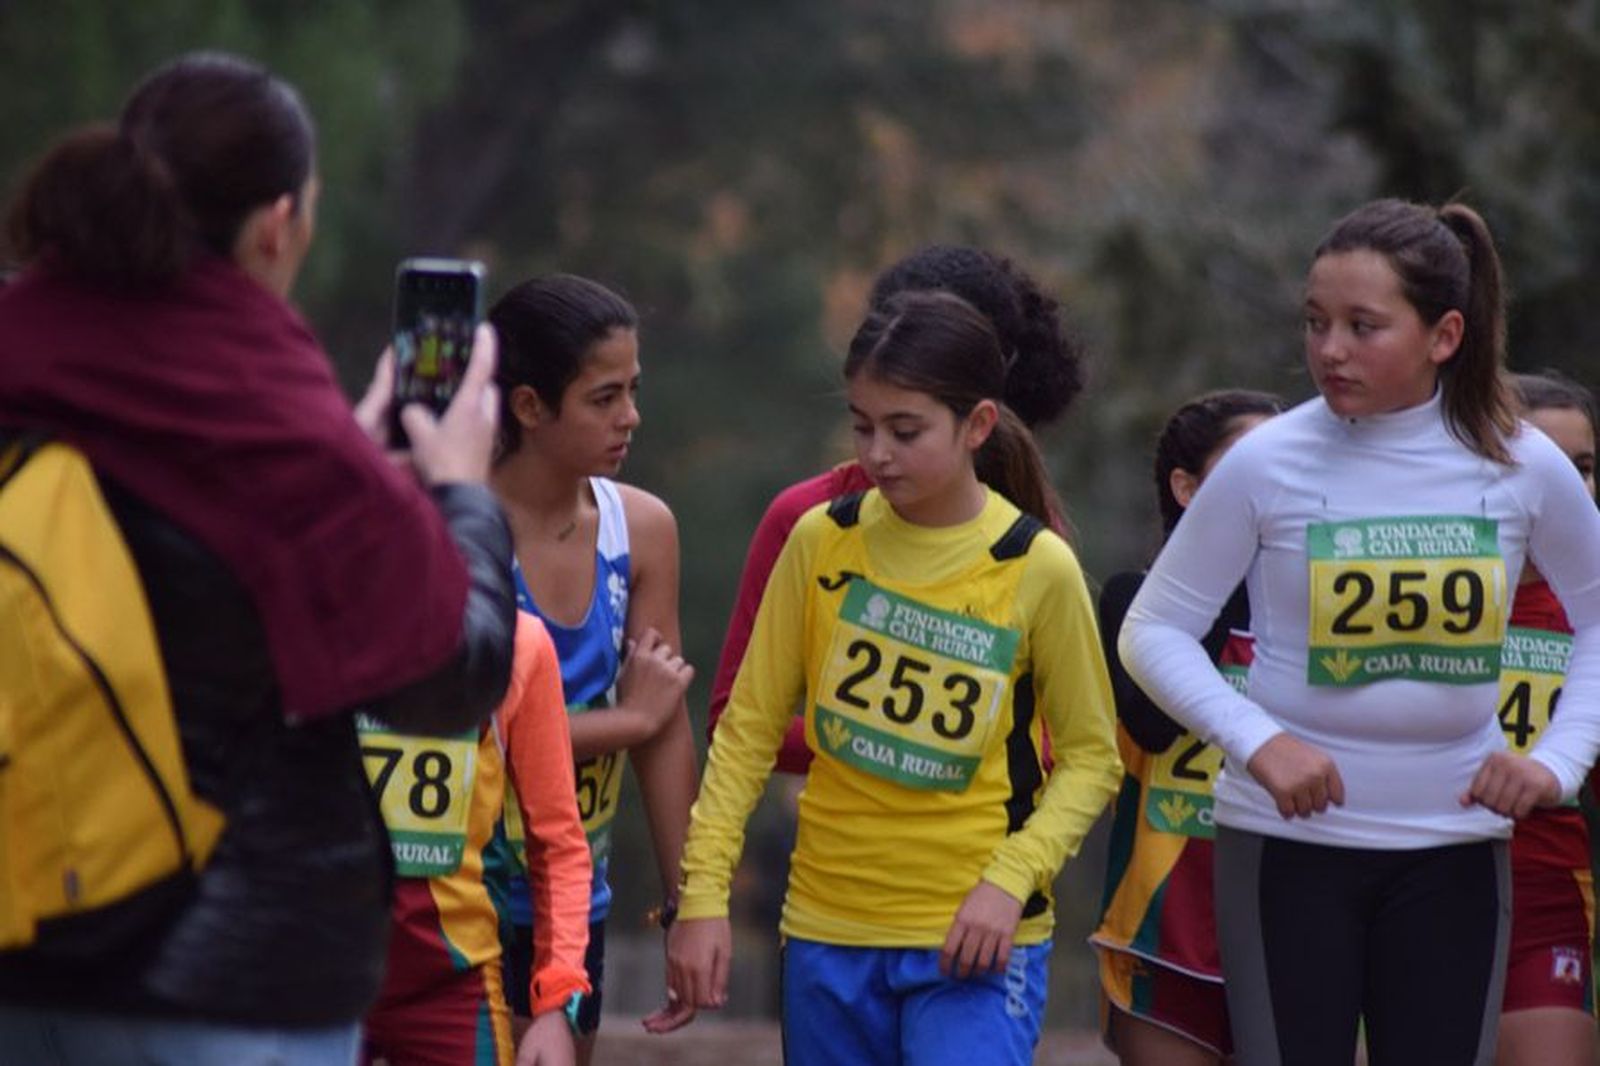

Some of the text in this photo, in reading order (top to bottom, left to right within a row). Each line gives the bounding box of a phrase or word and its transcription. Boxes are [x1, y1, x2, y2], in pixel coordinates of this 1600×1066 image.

[1416, 540, 1479, 556] RURAL
[1331, 569, 1484, 635] 259
[931, 635, 990, 666] RURAL
[1364, 655, 1490, 675] CAJA RURAL
[835, 639, 982, 740] 253
[851, 735, 965, 781] CAJA RURAL
[391, 841, 454, 866] RURAL
